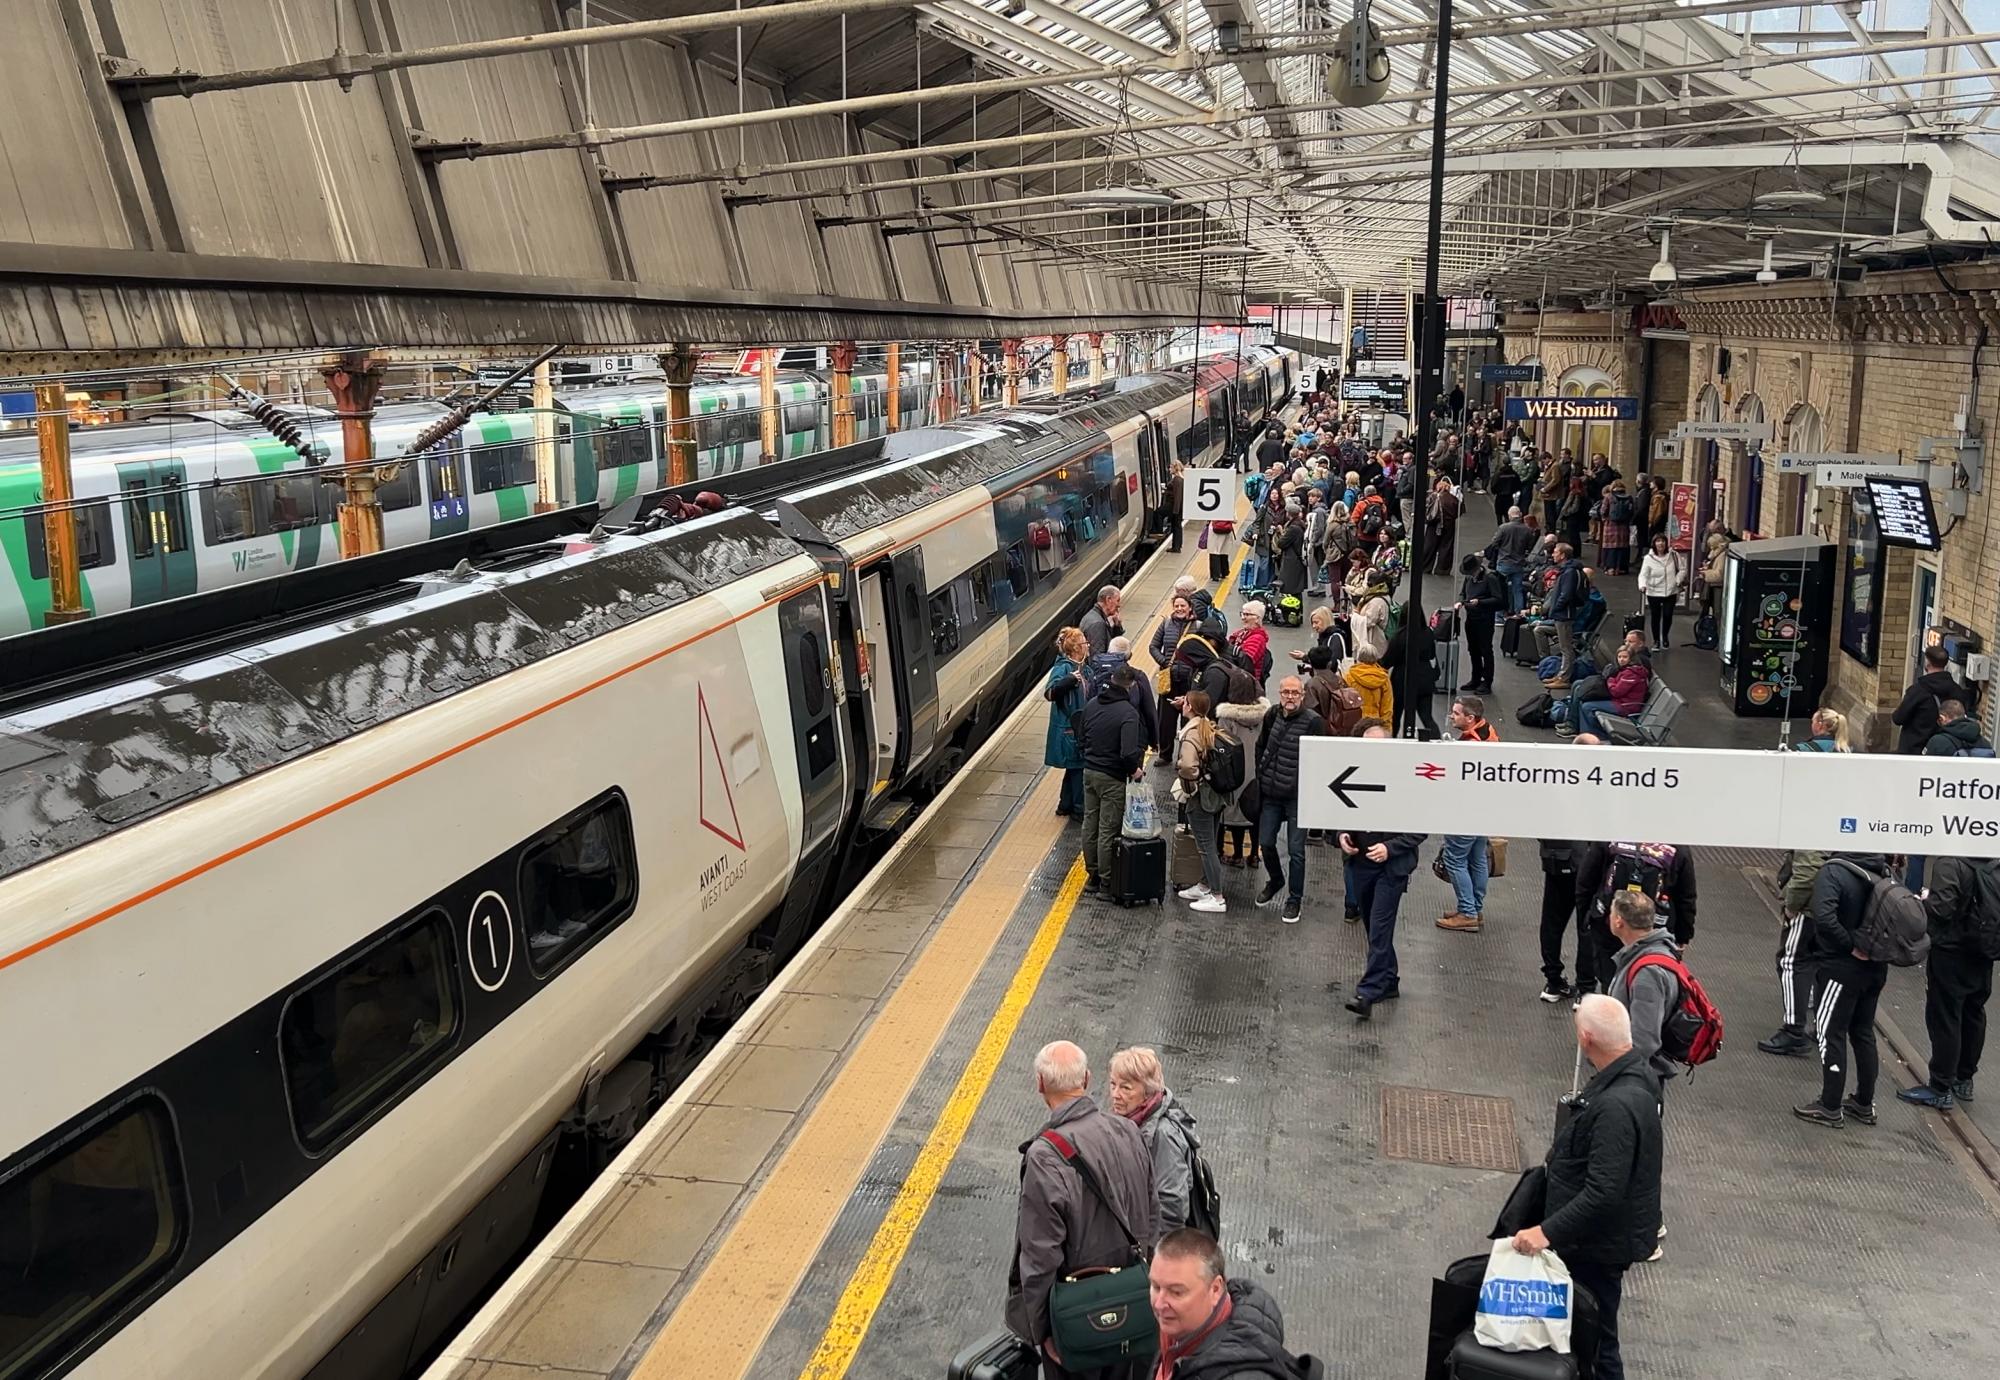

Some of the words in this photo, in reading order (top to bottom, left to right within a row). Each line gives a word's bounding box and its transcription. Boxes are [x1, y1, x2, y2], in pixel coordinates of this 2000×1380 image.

[605, 359, 613, 370] 6
[1331, 358, 1338, 366] 5
[1301, 375, 1311, 388] 5
[1524, 400, 1618, 418] WHSmith
[1694, 426, 1719, 434] Female
[1839, 471, 1864, 480] Male
[1196, 478, 1221, 512] 5
[1461, 761, 1579, 785] Platforms
[1587, 766, 1603, 785] 4
[1610, 767, 1656, 788] and
[1663, 769, 1679, 788] 5
[1868, 820, 1890, 833] via
[1894, 822, 1934, 836] ramp
[1942, 815, 2000, 837] Wes
[700, 853, 729, 892] AVANTI
[700, 880, 722, 912] WEST
[724, 858, 748, 892] COAST
[482, 915, 498, 969] 1
